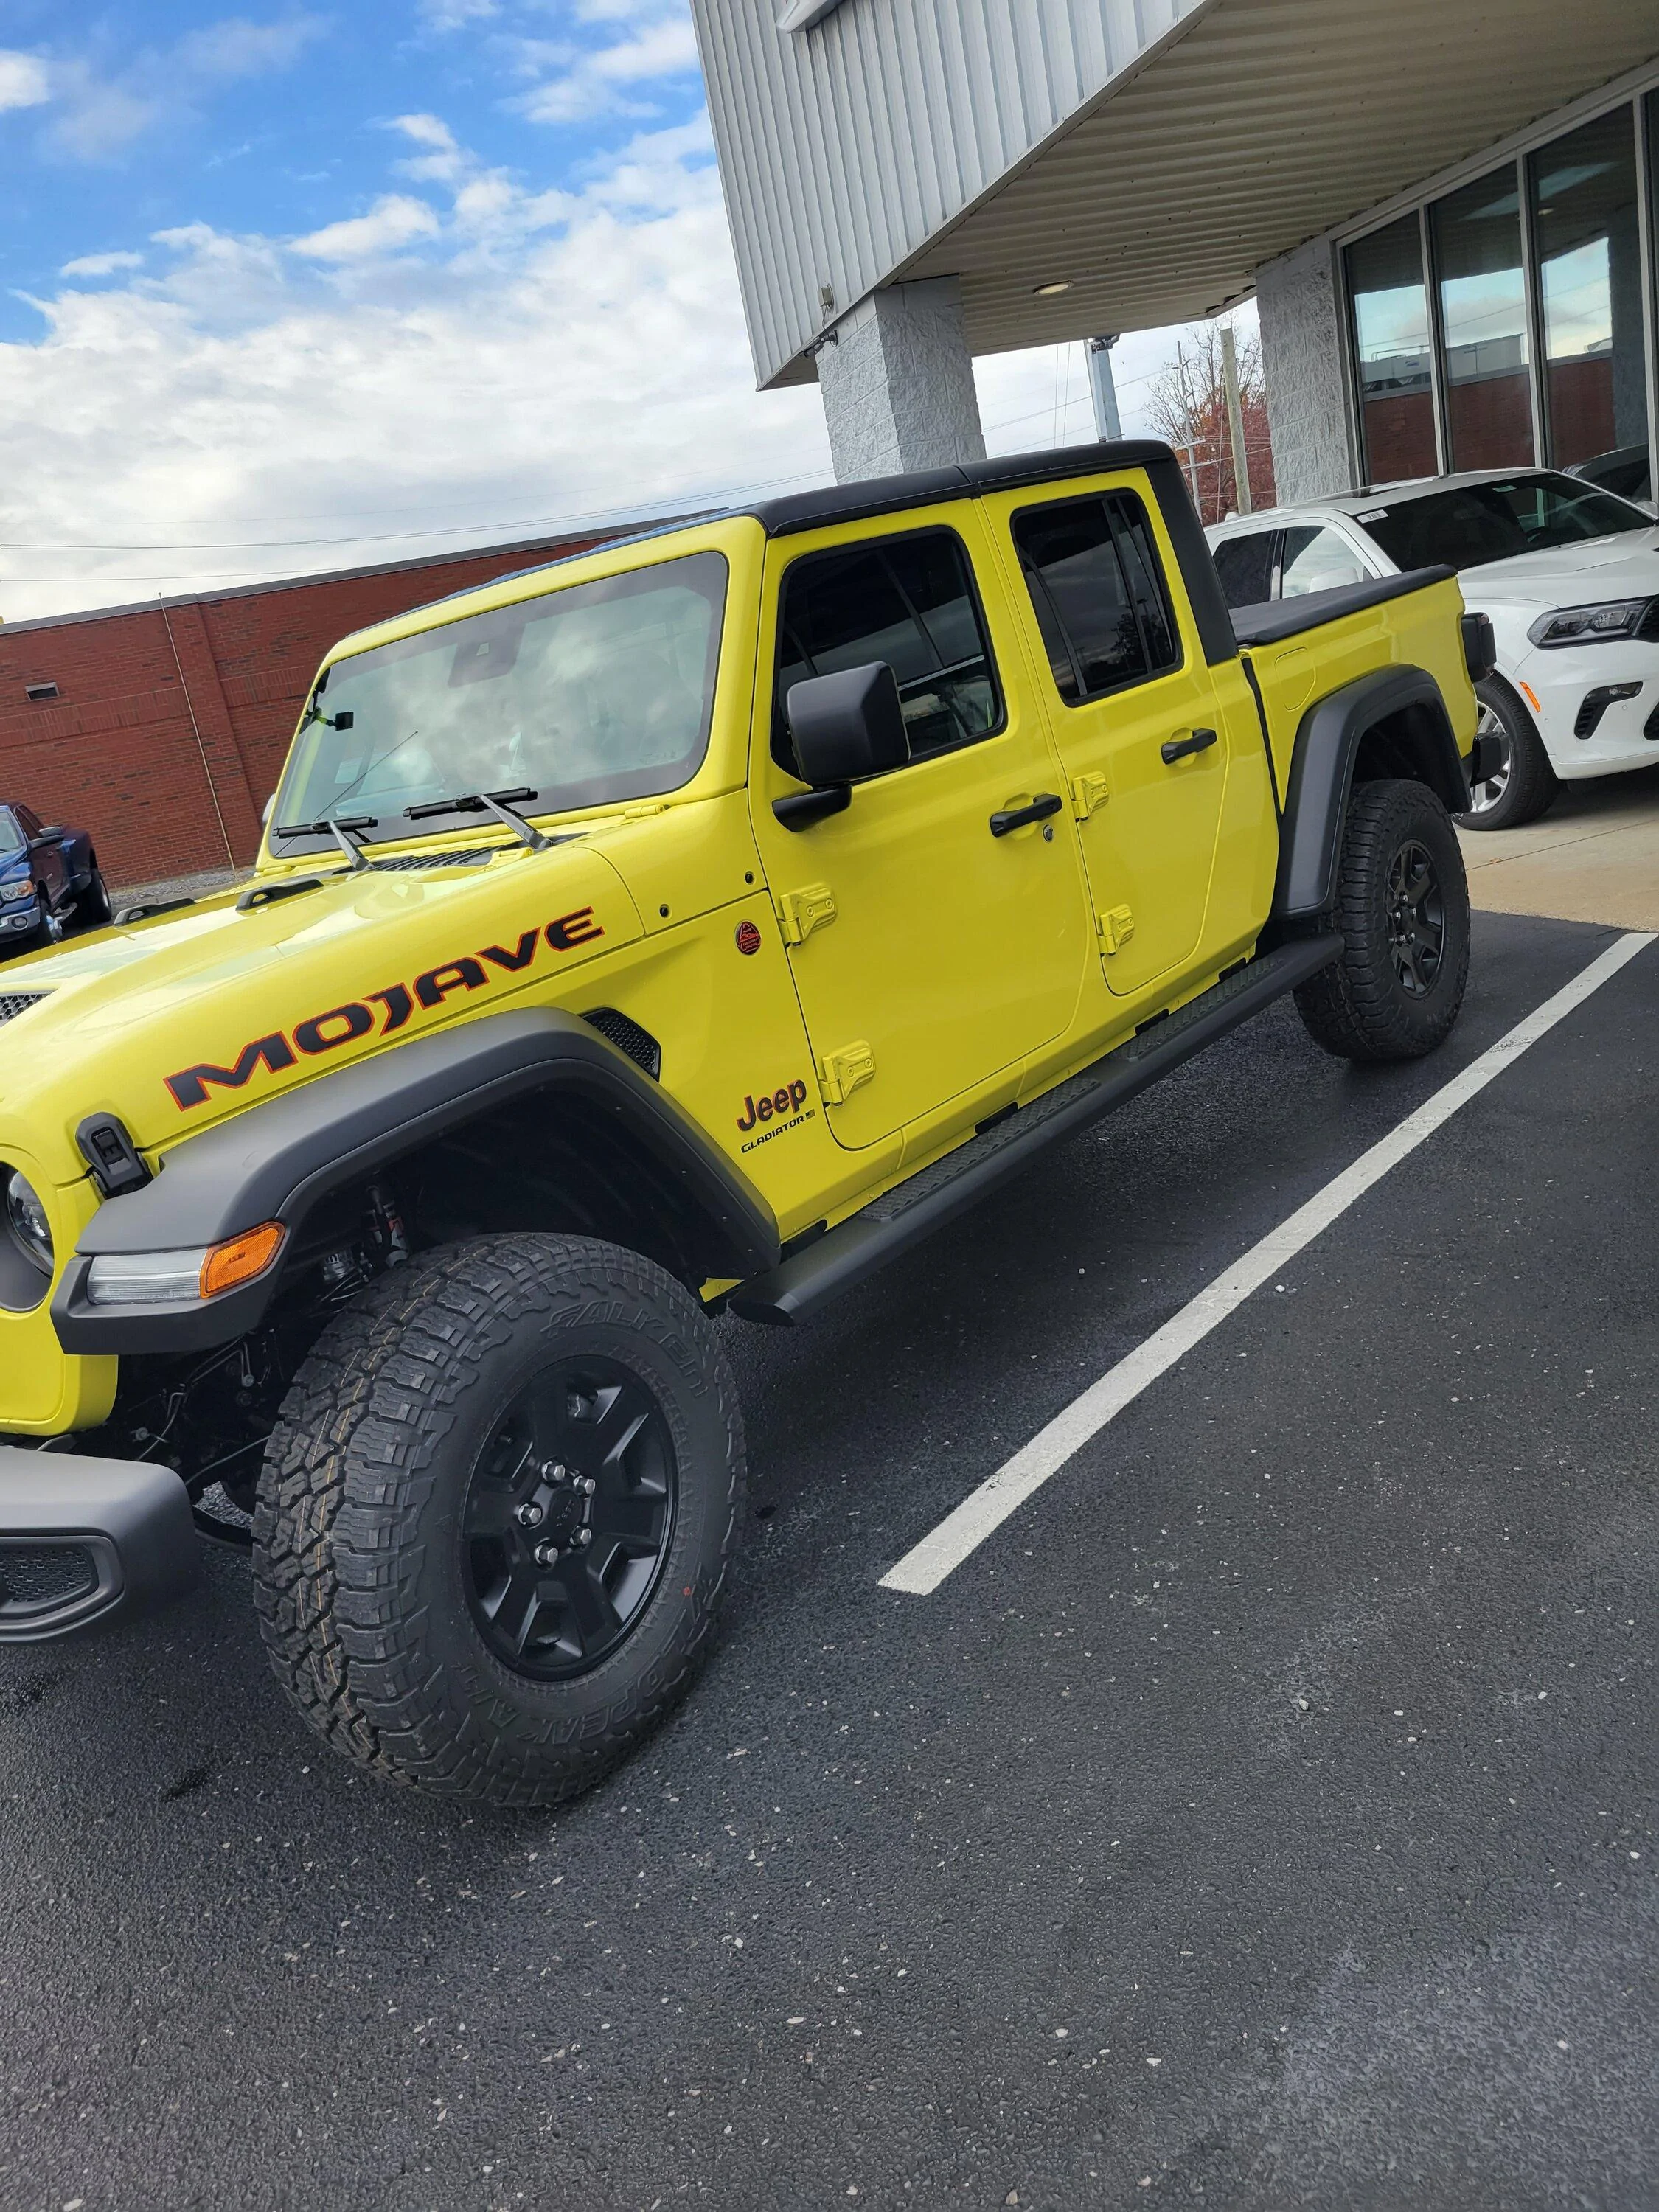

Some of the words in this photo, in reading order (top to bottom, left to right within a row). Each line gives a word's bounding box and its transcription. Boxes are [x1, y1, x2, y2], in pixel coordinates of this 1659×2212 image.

[163, 906, 605, 1112] MOJAVE
[737, 1079, 807, 1132] Jeep
[741, 1116, 805, 1153] GLADIATOR
